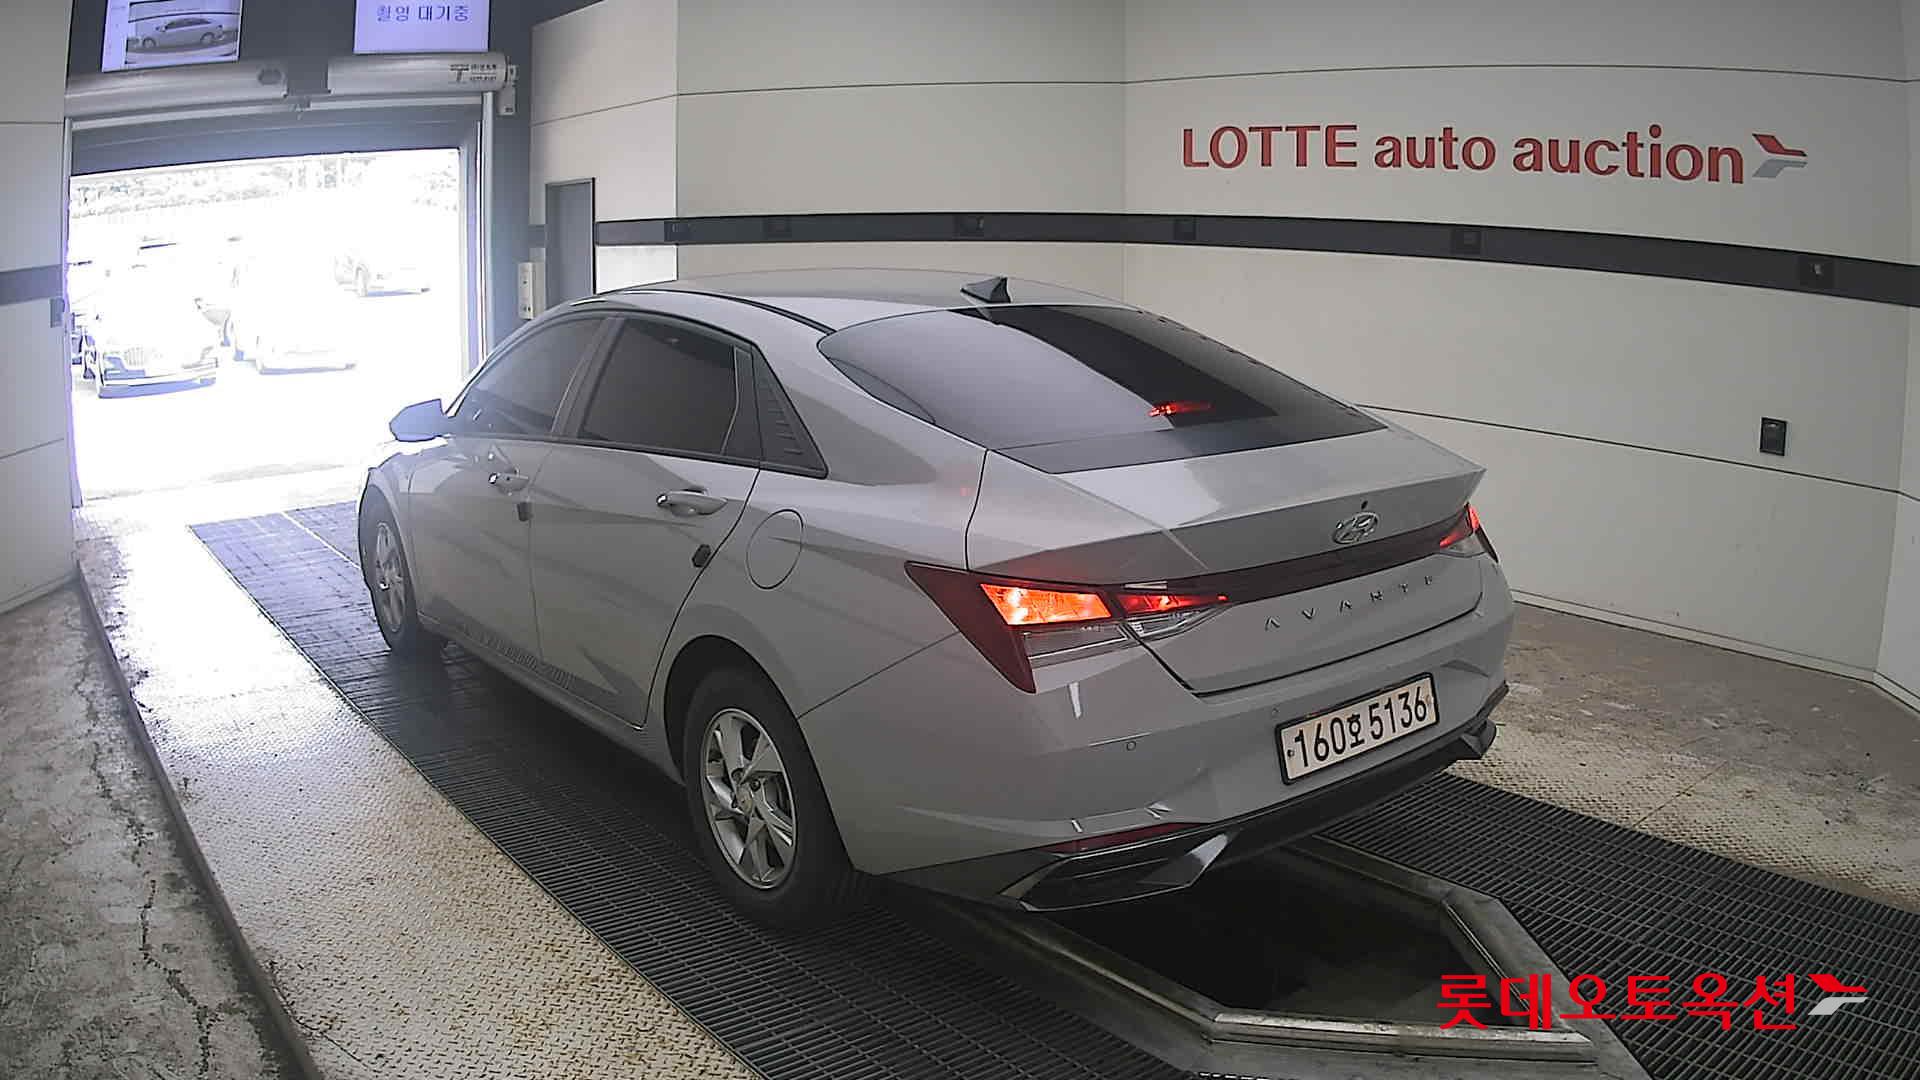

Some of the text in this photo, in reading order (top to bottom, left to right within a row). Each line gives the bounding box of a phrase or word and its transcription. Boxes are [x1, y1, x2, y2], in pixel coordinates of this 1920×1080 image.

[418, 4, 470, 22] 대기중
[1183, 125, 1744, 184] LOTTE auto auction
